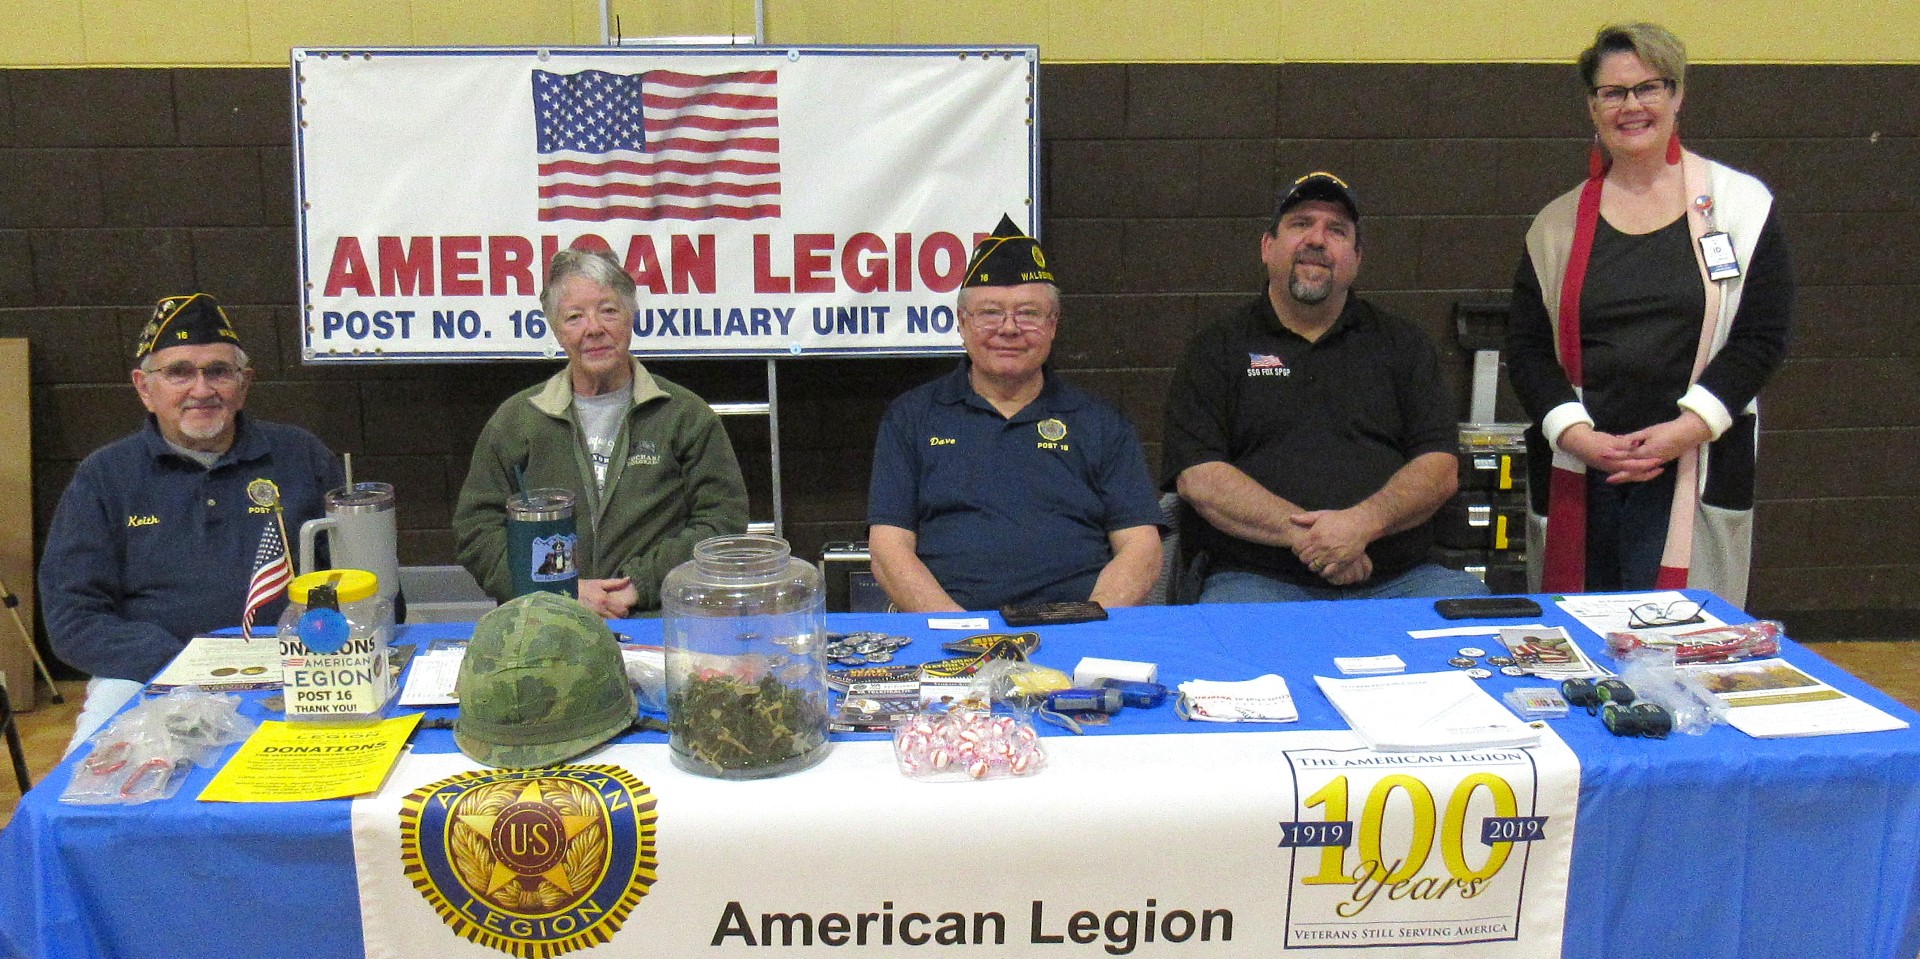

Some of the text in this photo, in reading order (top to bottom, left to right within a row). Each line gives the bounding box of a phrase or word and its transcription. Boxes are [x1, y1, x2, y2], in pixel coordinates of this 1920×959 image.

[753, 231, 993, 294] LEGIO
[980, 273, 989, 282] 16
[323, 310, 415, 339] POST
[433, 309, 491, 339] NO.
[509, 309, 546, 339] 16
[632, 307, 796, 337] UXILIARY
[812, 305, 890, 336] UNIT
[176, 331, 188, 340] 16
[1261, 368, 1274, 376] FOX
[929, 436, 956, 446] Dave
[127, 514, 160, 527] Keith
[304, 656, 371, 668] AMERICAN
[282, 668, 373, 687] LEGION
[297, 690, 352, 701] POST 16
[295, 704, 357, 713] THANK YOU!
[263, 741, 388, 754] DONATIONS
[1296, 752, 1523, 767] THE AMERICAN LEGION
[437, 770, 629, 812] AMERICAN
[1290, 825, 1344, 843] 1919
[1300, 772, 1519, 886] 100
[1488, 822, 1539, 839] 2019
[1335, 858, 1493, 918] Years
[461, 899, 603, 938] LEGION
[711, 899, 1235, 956] American Legion
[1294, 923, 1508, 940] VETERANS STILL SERVING AMERICA
